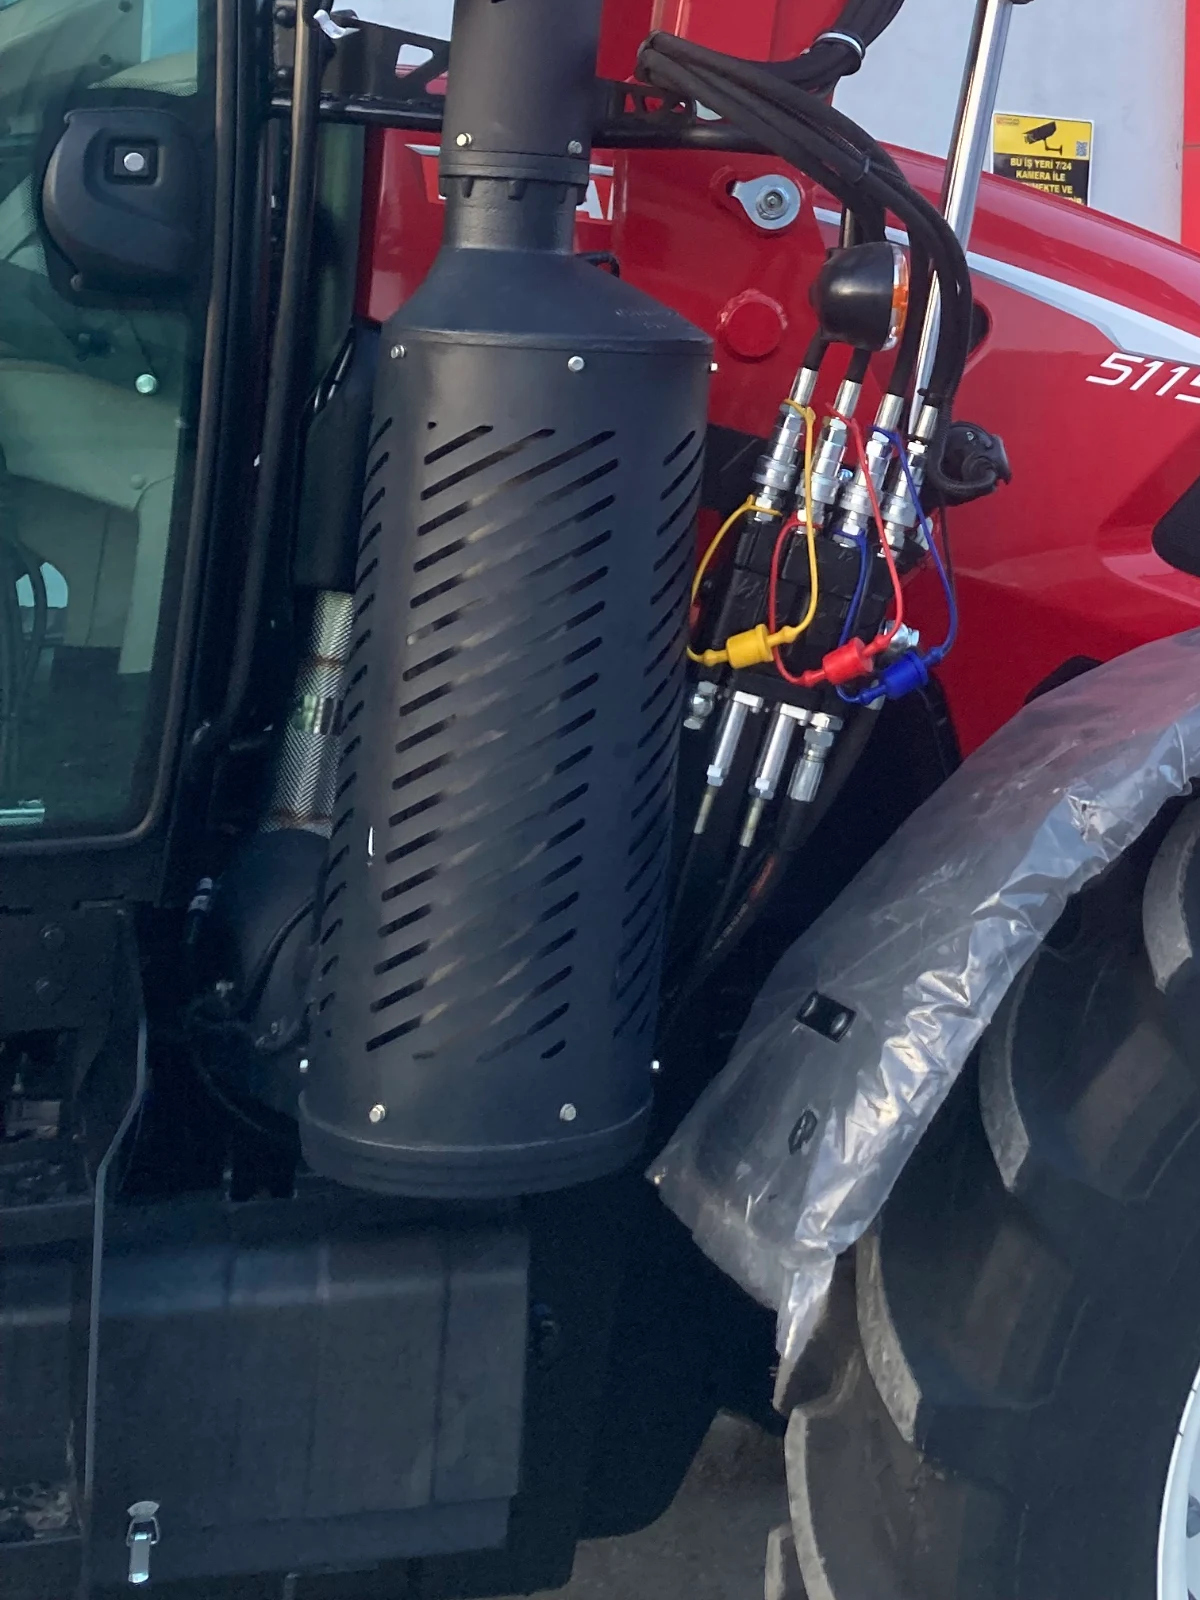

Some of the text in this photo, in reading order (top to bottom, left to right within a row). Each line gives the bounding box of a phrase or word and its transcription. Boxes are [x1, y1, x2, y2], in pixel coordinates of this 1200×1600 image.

[1010, 157, 1022, 167] BU
[1034, 159, 1053, 170] YERİ
[1015, 170, 1066, 181] KAMERA İLE
[1062, 184, 1073, 194] VE
